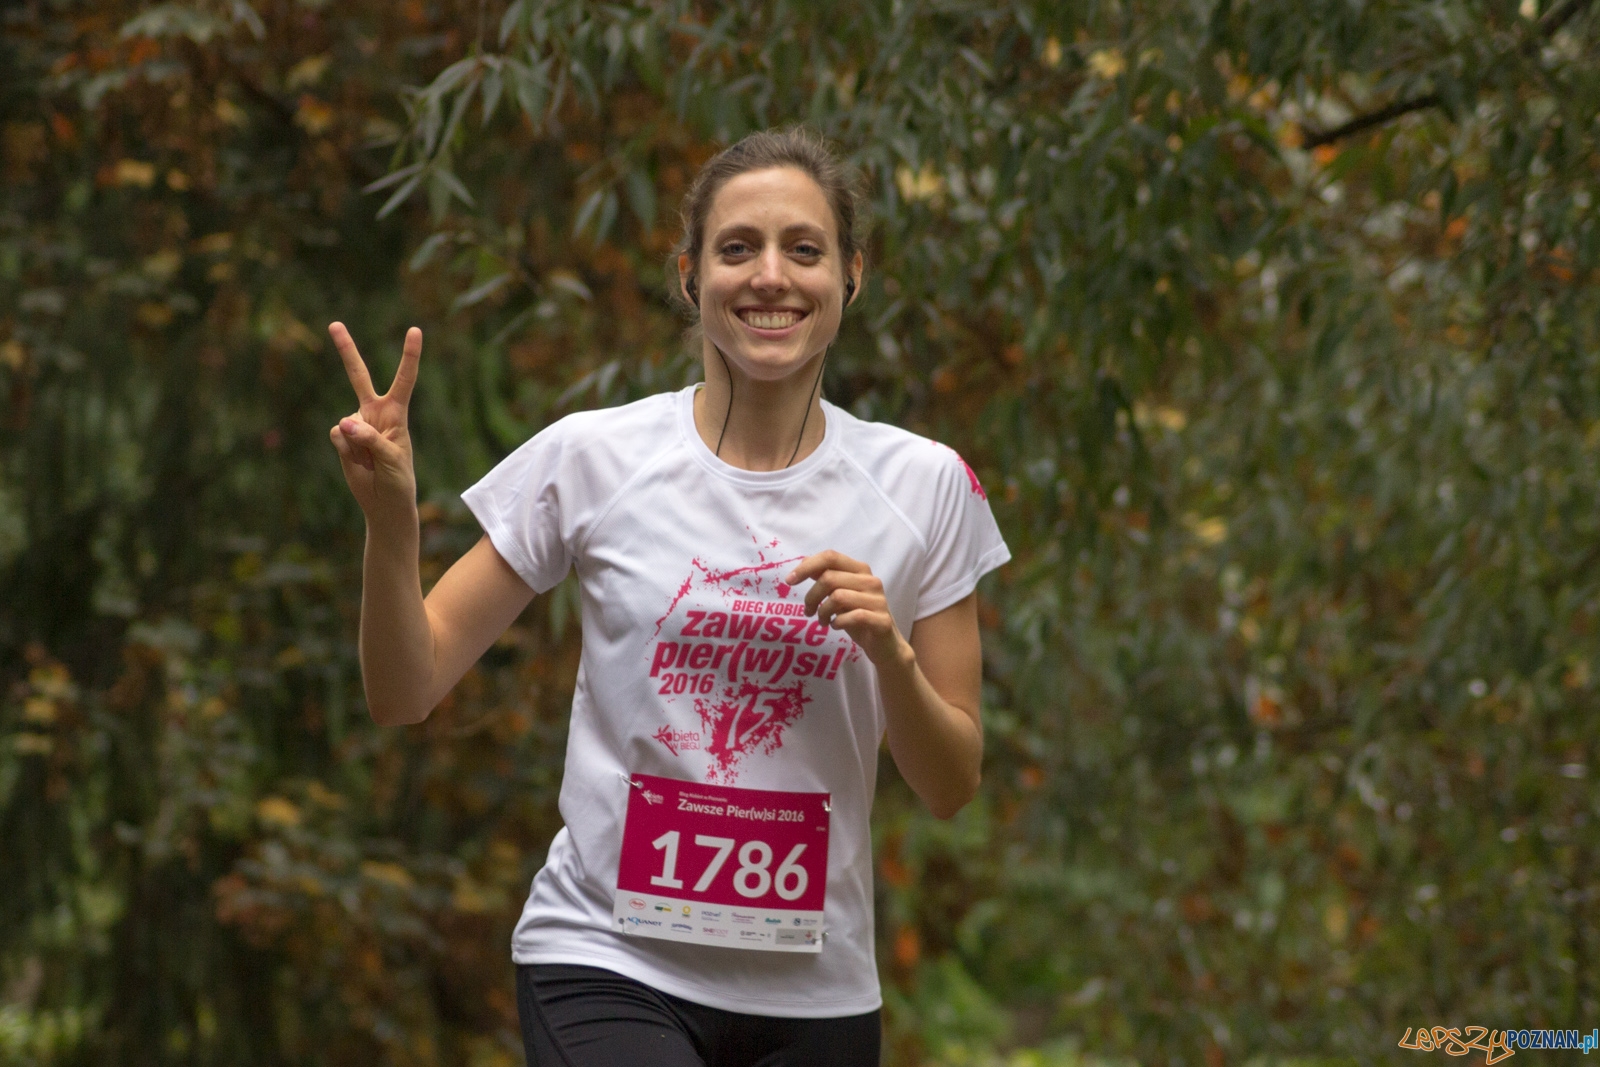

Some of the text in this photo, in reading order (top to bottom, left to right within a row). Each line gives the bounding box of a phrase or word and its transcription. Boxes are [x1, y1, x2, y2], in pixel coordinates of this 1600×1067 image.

[732, 599, 805, 617] BIEG KOBIE
[680, 610, 830, 647] zawsze
[658, 672, 716, 695] 2016
[677, 798, 805, 822] Zawsze Pier(w)si 2016
[650, 830, 809, 901] 1786
